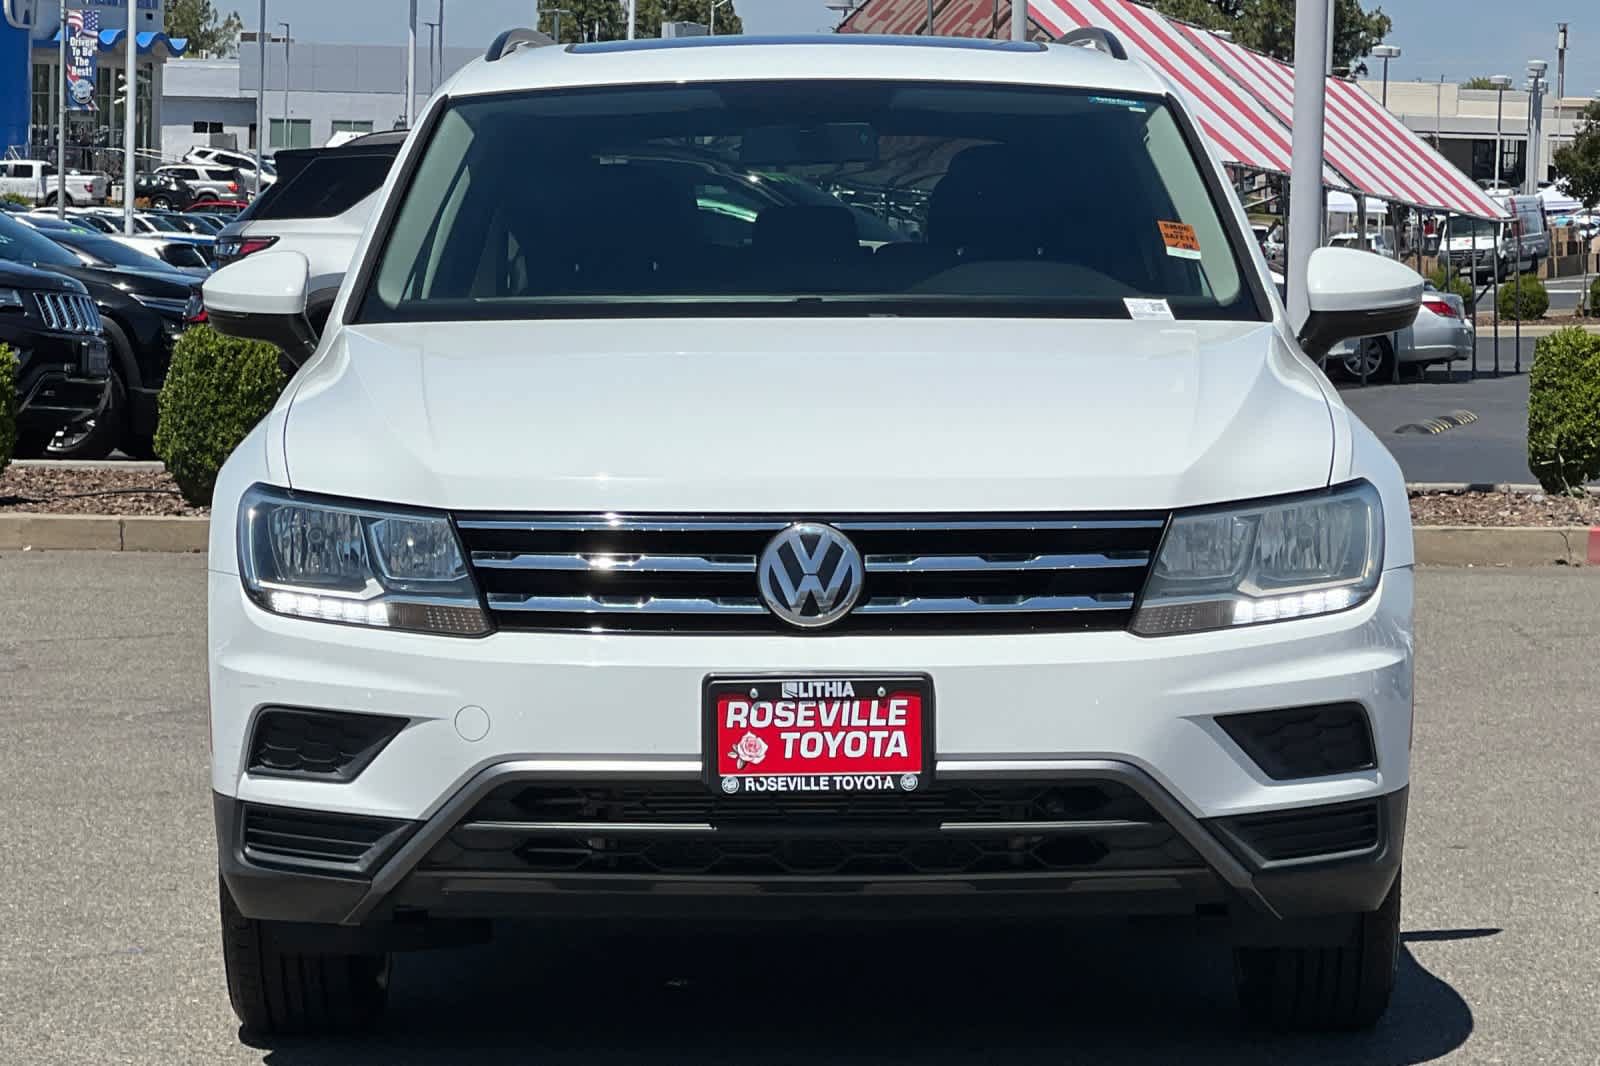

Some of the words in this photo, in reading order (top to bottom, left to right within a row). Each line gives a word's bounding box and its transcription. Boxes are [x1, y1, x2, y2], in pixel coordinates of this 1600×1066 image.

[75, 57, 90, 67] The
[760, 523, 861, 626] VW
[797, 681, 855, 698] LITHIA
[726, 699, 909, 729] ROSEVILLE
[780, 730, 909, 759] TOYOTA
[744, 776, 830, 792] ROSEVILLE
[833, 775, 895, 791] TOYOTA
